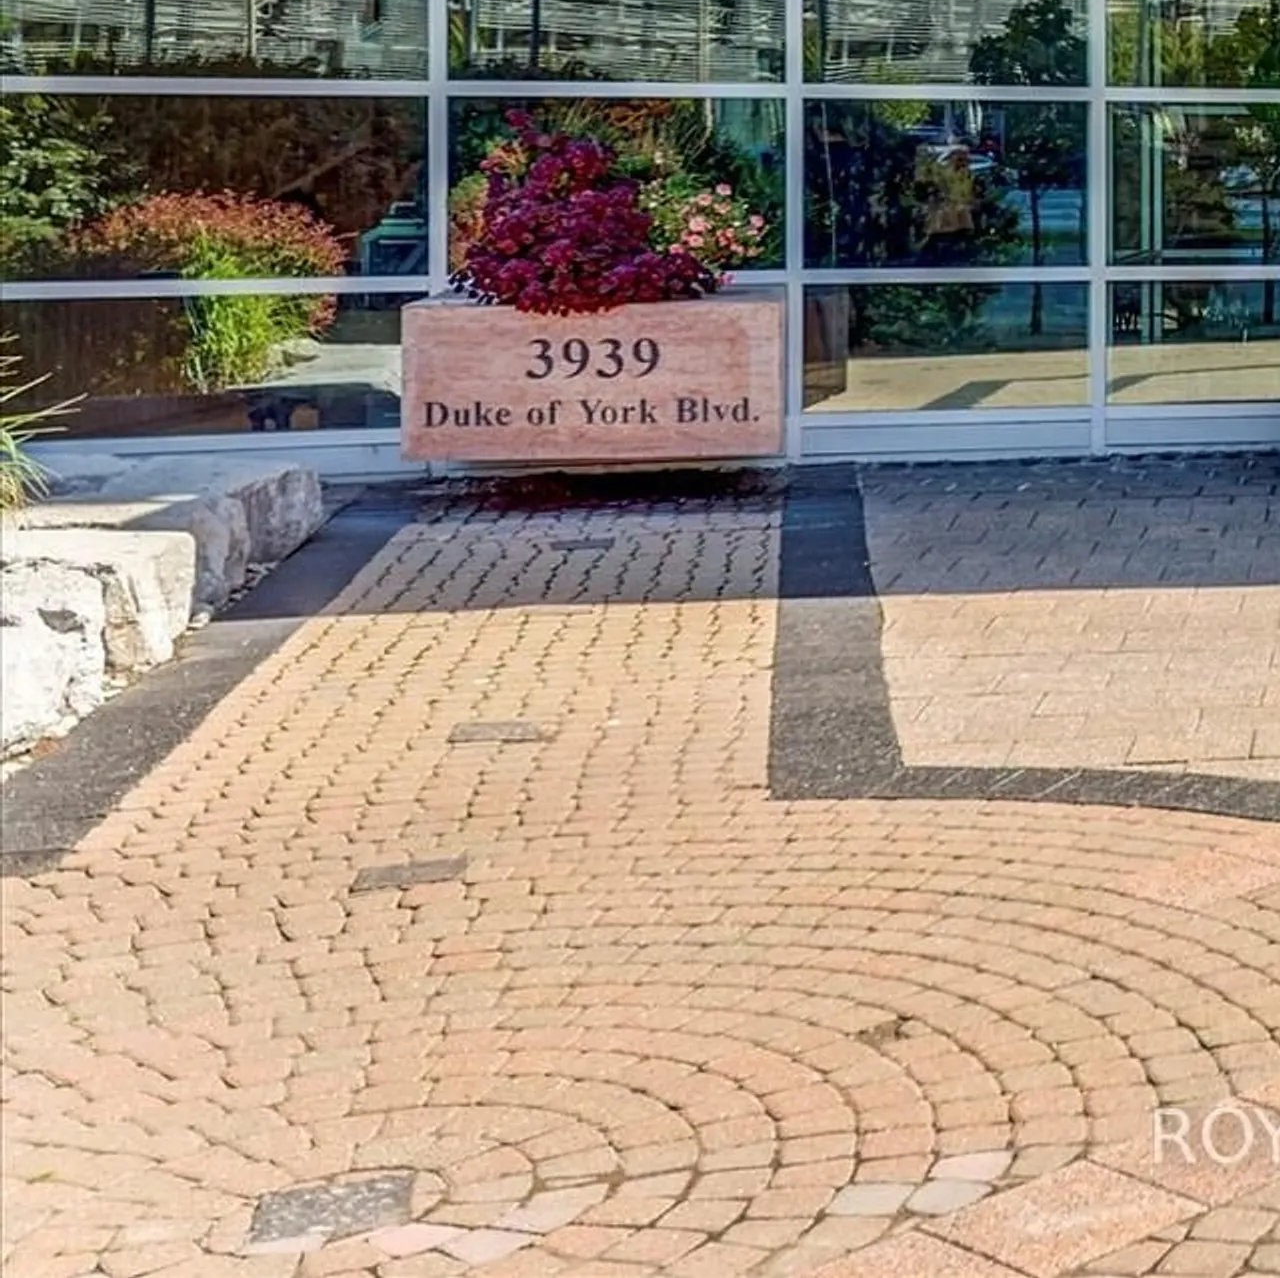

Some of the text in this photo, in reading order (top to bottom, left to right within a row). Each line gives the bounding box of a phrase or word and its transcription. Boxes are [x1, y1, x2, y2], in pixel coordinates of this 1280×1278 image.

[525, 337, 660, 380] 3939
[423, 396, 761, 428] Duke of York Blvd.
